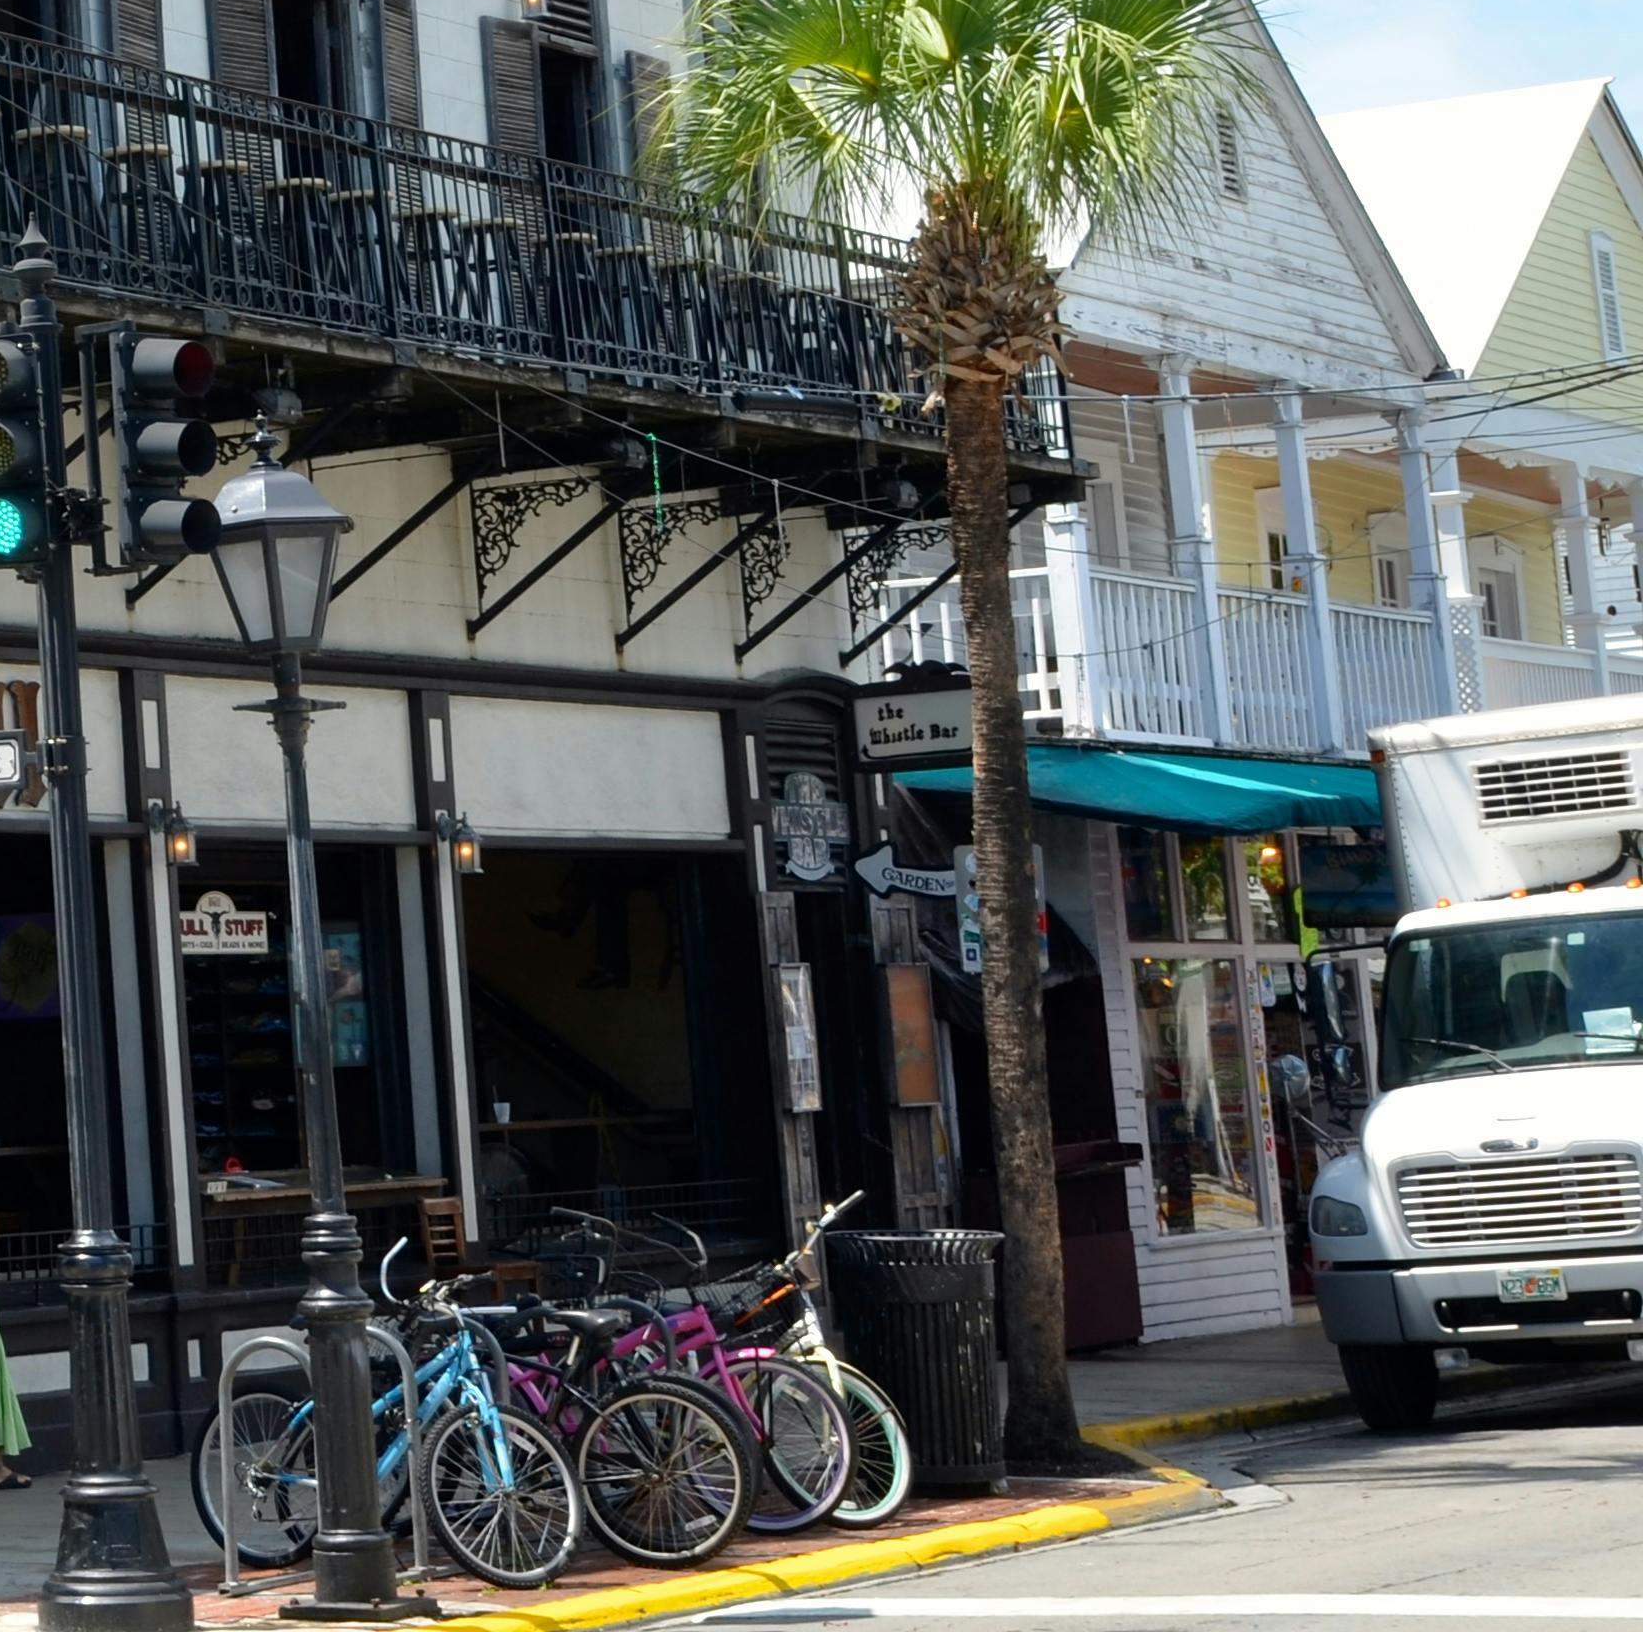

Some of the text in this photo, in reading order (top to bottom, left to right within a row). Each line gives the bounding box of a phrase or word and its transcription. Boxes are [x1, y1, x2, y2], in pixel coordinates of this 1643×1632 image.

[877, 703, 905, 722] the
[869, 724, 958, 745] Whistle Bar
[881, 867, 945, 892] GARDEN
[224, 919, 264, 936] STUFF
